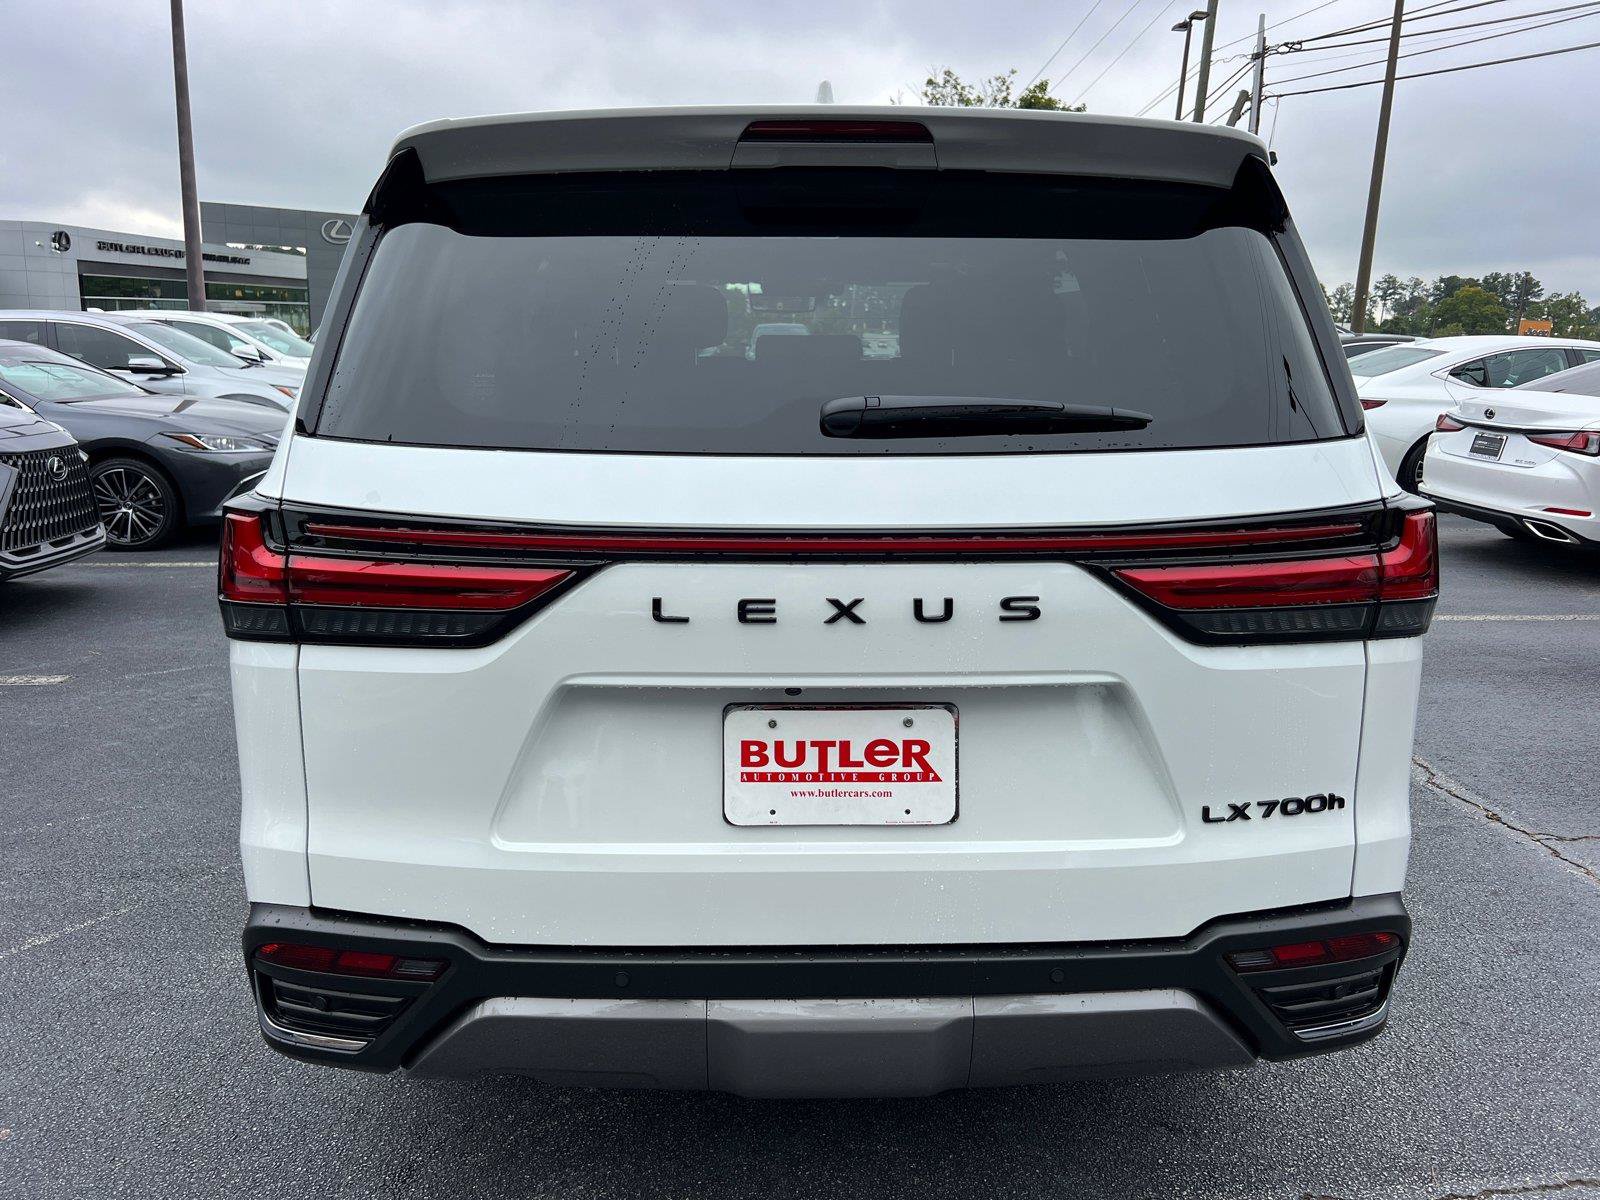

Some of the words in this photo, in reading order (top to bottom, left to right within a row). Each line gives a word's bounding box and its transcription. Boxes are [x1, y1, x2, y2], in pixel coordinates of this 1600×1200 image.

[651, 596, 1042, 625] LEXUS
[740, 772, 859, 782] AUTOMOTIVE
[878, 772, 936, 782] GROUP
[790, 788, 893, 799] www.butlercars.com
[1202, 801, 1252, 824] LX
[1256, 793, 1346, 819] 700h
